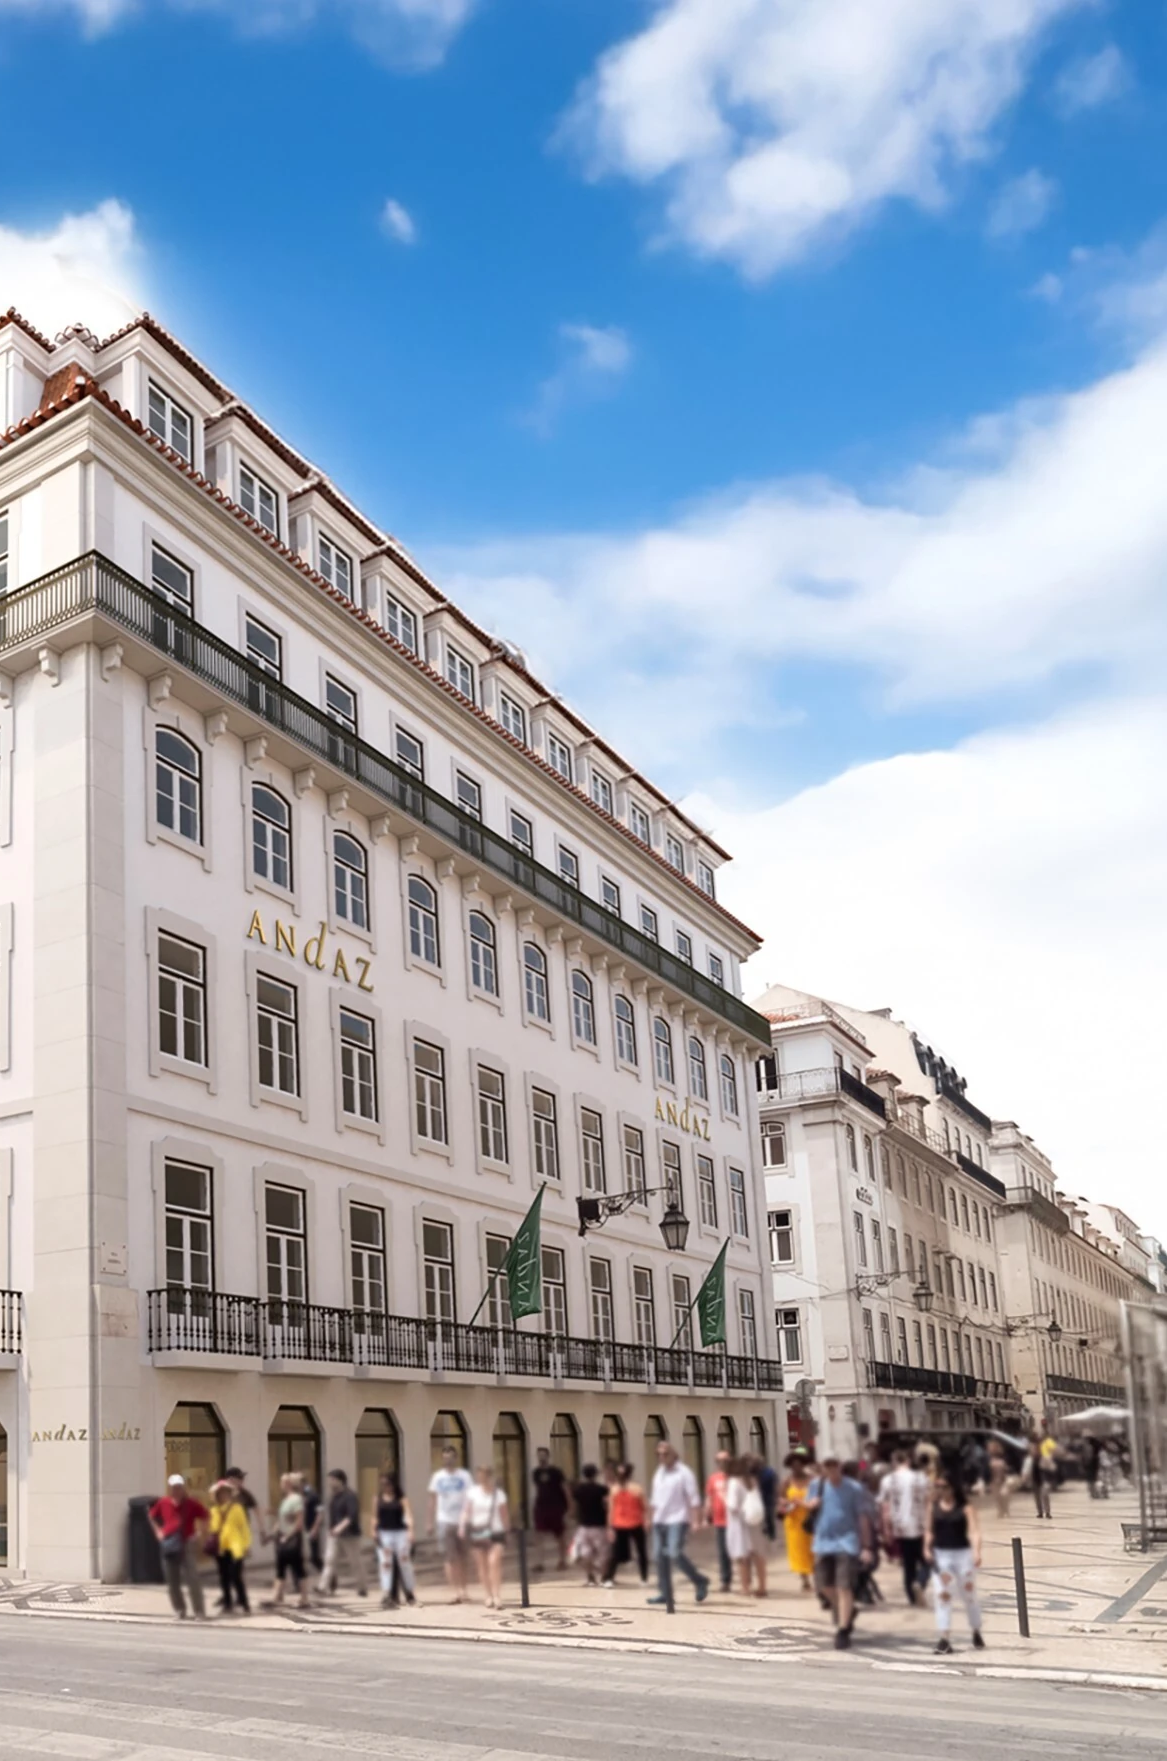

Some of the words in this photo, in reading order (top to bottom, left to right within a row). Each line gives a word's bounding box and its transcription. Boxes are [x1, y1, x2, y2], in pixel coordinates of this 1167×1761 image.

[246, 909, 374, 993] ANdAZ
[655, 1096, 711, 1142] ANdAZ
[32, 1423, 88, 1441] ANdAZ
